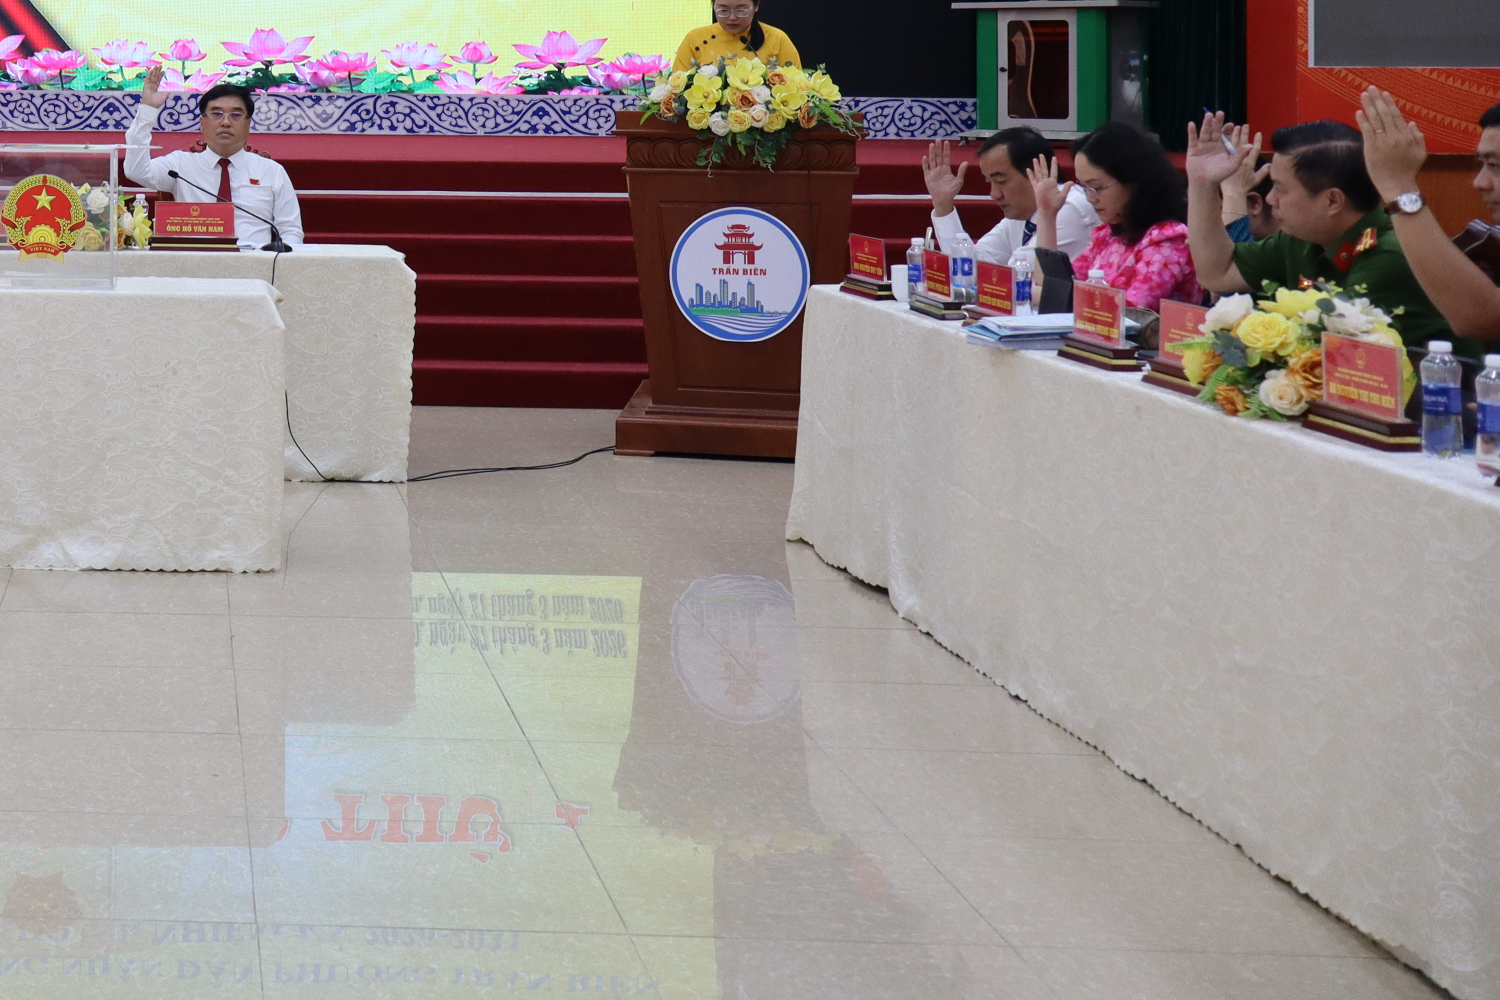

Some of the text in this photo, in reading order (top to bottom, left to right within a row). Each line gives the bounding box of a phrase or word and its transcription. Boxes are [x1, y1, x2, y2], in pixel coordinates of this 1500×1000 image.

[166, 224, 180, 232] ÔNG
[712, 265, 766, 276] TRẤN BIÊN
